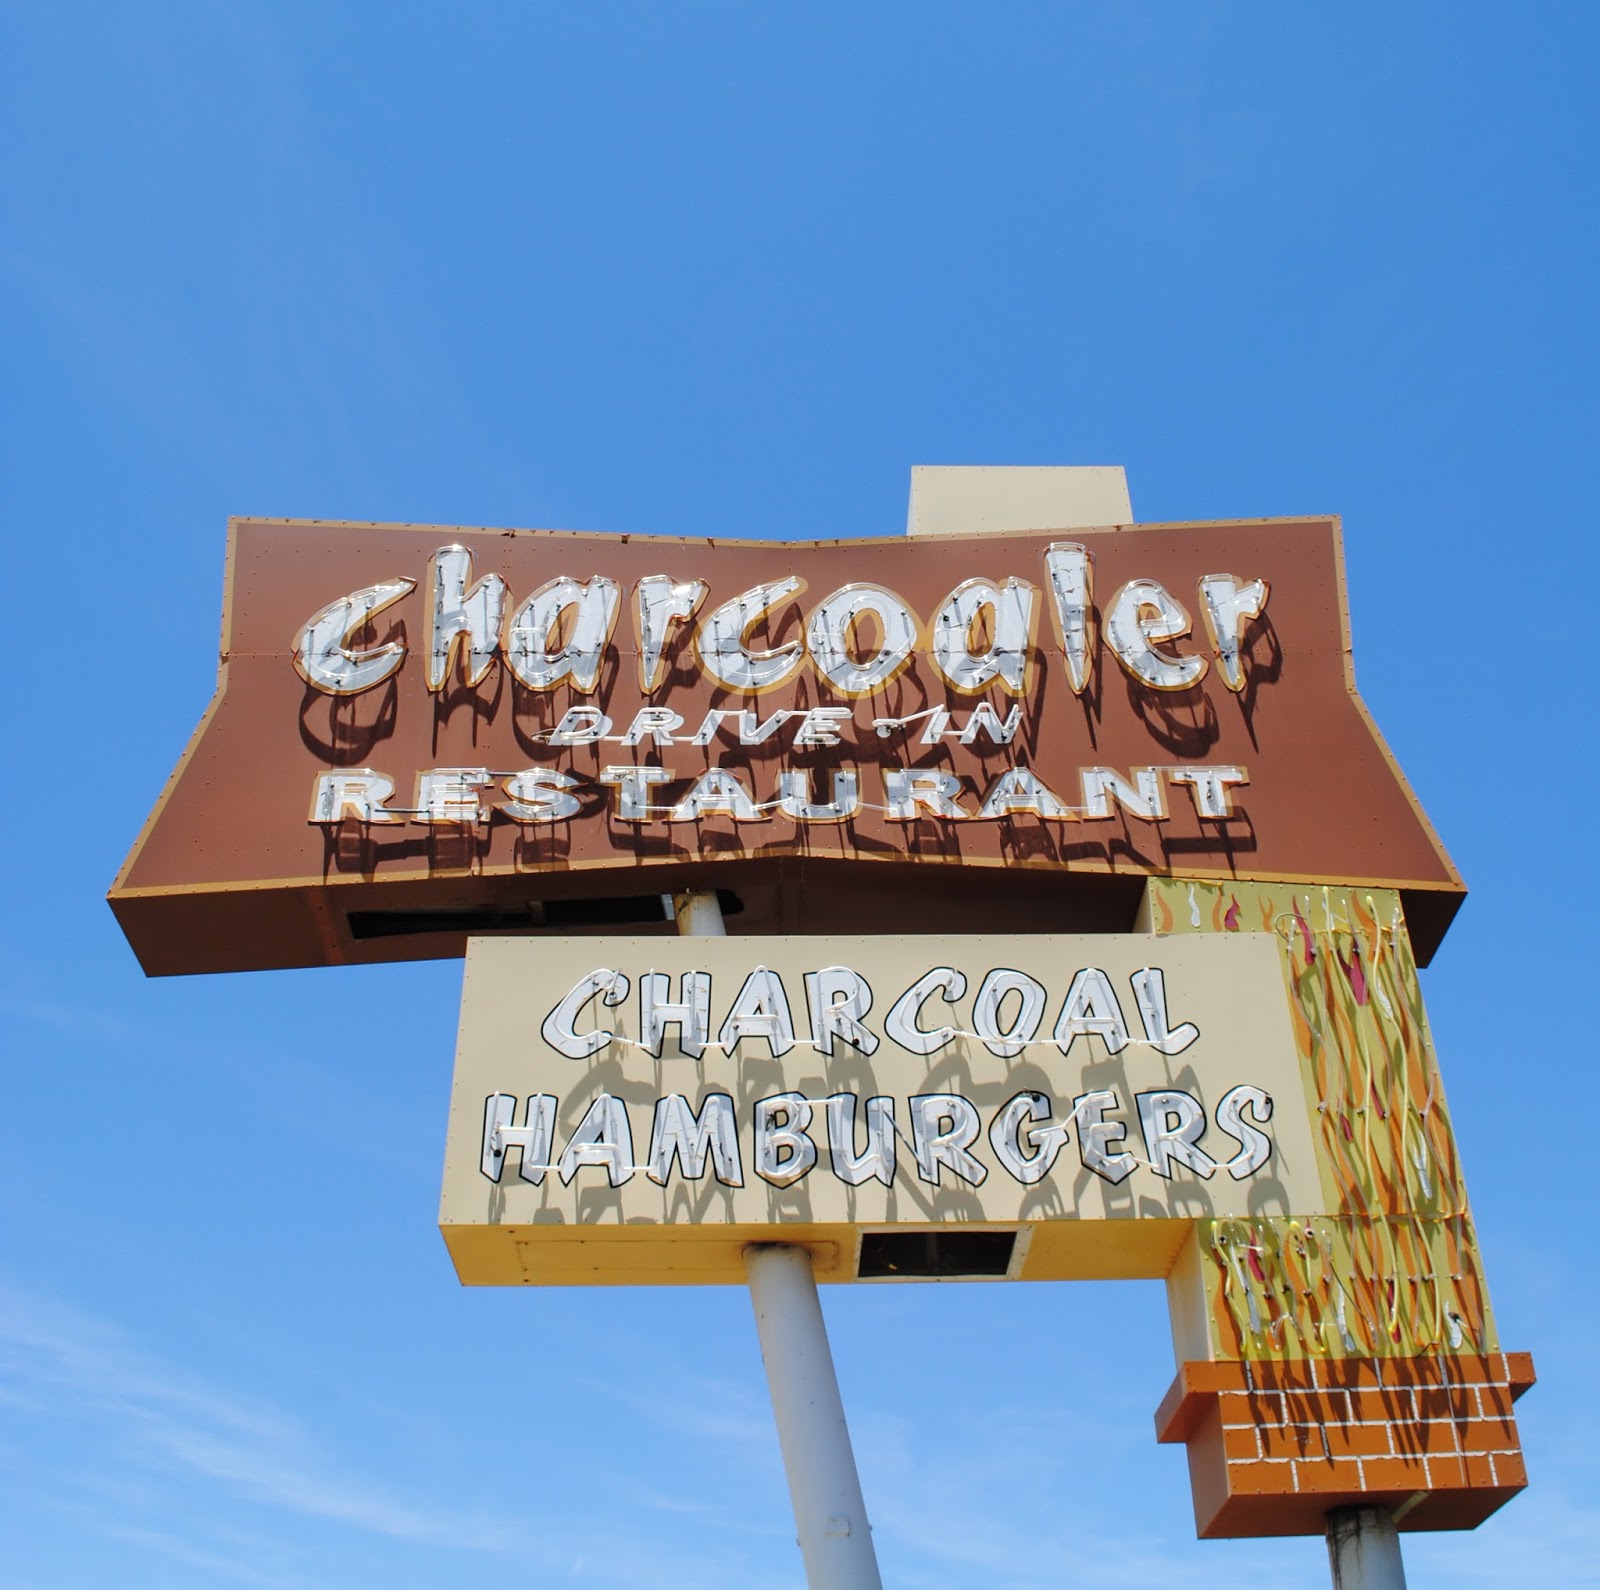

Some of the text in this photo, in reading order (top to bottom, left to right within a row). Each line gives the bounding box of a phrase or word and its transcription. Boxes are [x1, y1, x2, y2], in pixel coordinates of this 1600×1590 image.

[308, 766, 1250, 825] RESTAURANT
[541, 965, 1200, 1060] CHARCOAL
[480, 1085, 1274, 1189] HAMBURGERS
